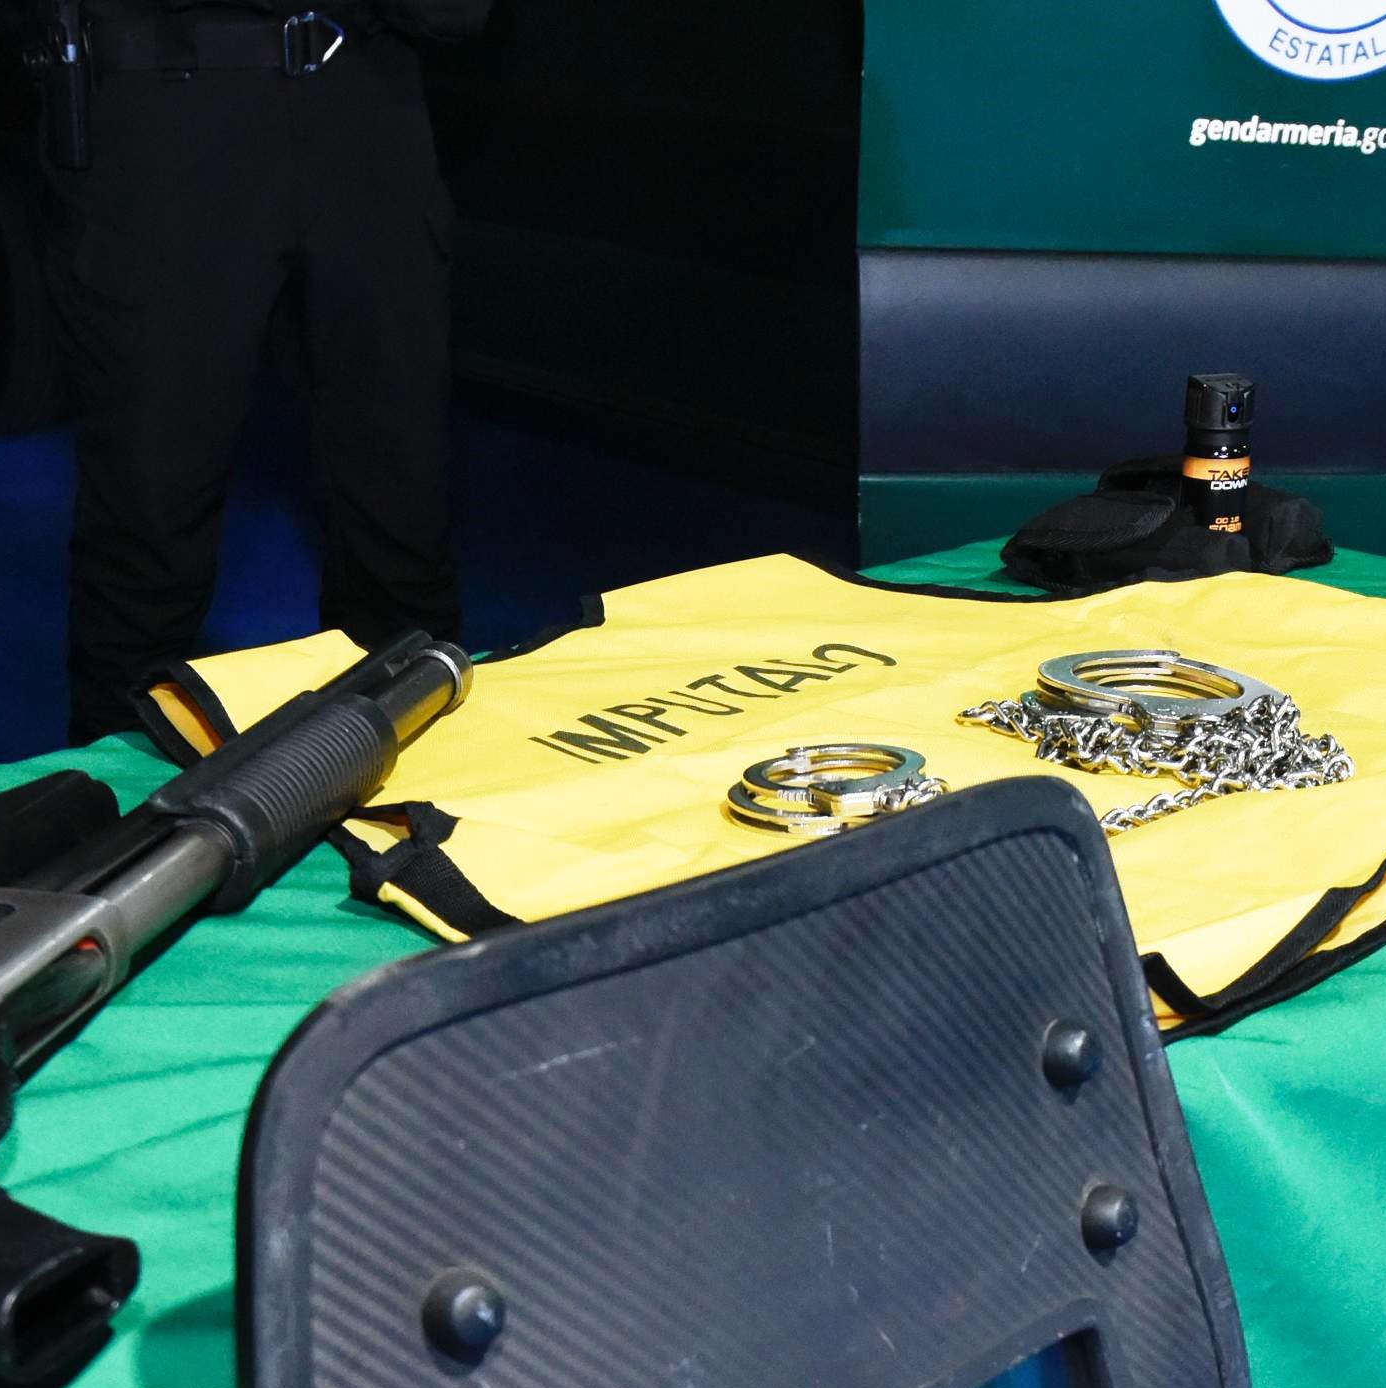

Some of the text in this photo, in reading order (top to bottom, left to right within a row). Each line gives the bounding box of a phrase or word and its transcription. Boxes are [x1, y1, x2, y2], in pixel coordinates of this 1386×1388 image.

[1268, 28, 1386, 67] ESTATAL
[1208, 467, 1250, 481] TAKE
[1210, 479, 1248, 490] DOWN
